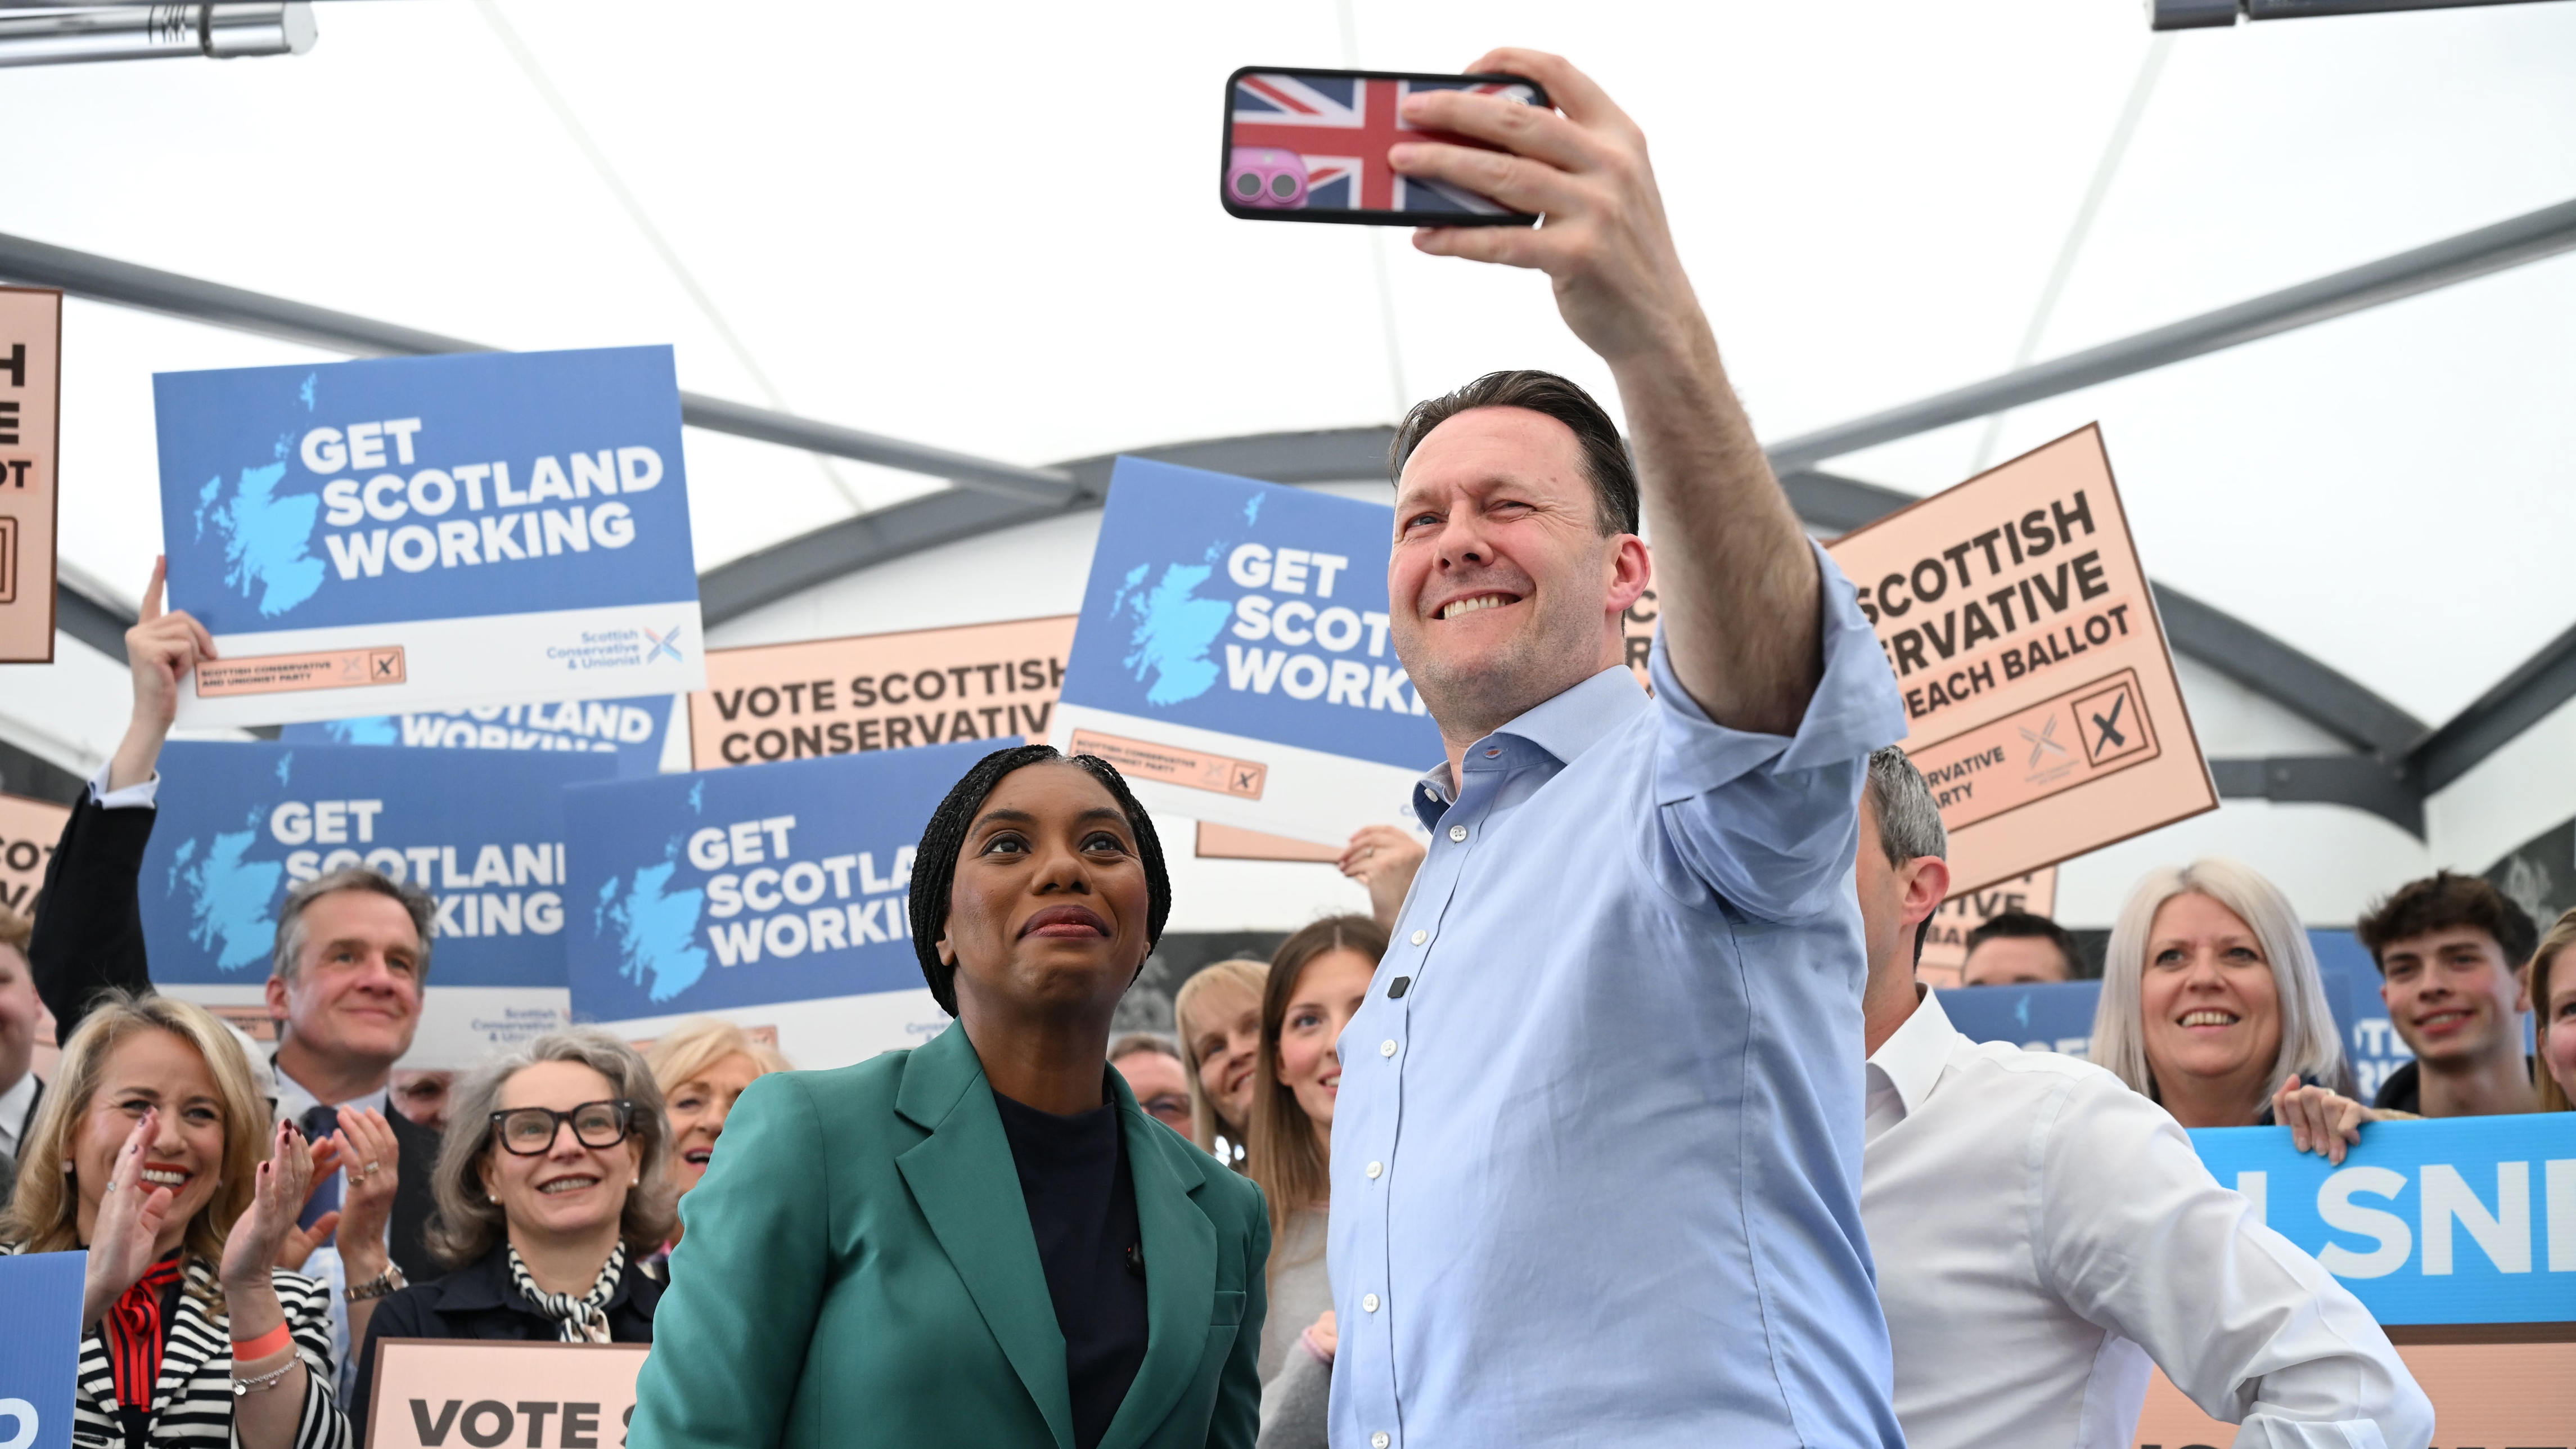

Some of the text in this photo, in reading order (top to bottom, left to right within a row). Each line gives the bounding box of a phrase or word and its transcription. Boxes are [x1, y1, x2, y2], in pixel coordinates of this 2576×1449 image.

[300, 417, 422, 475] GET
[322, 446, 664, 526] SCOTLAND
[324, 501, 636, 580] WORKING
[1227, 542, 1348, 598] GET
[546, 642, 640, 659] Conservative
[581, 629, 638, 644] Scottish
[1231, 595, 1391, 659] SCOT
[568, 654, 641, 670] & Unionist
[1902, 603, 2129, 719] EACH BALLOT
[713, 680, 836, 722] VOTE
[270, 799, 382, 845] GET
[687, 814, 796, 871] GET
[707, 896, 914, 968] WORKI
[408, 1398, 601, 1449] VOTE
